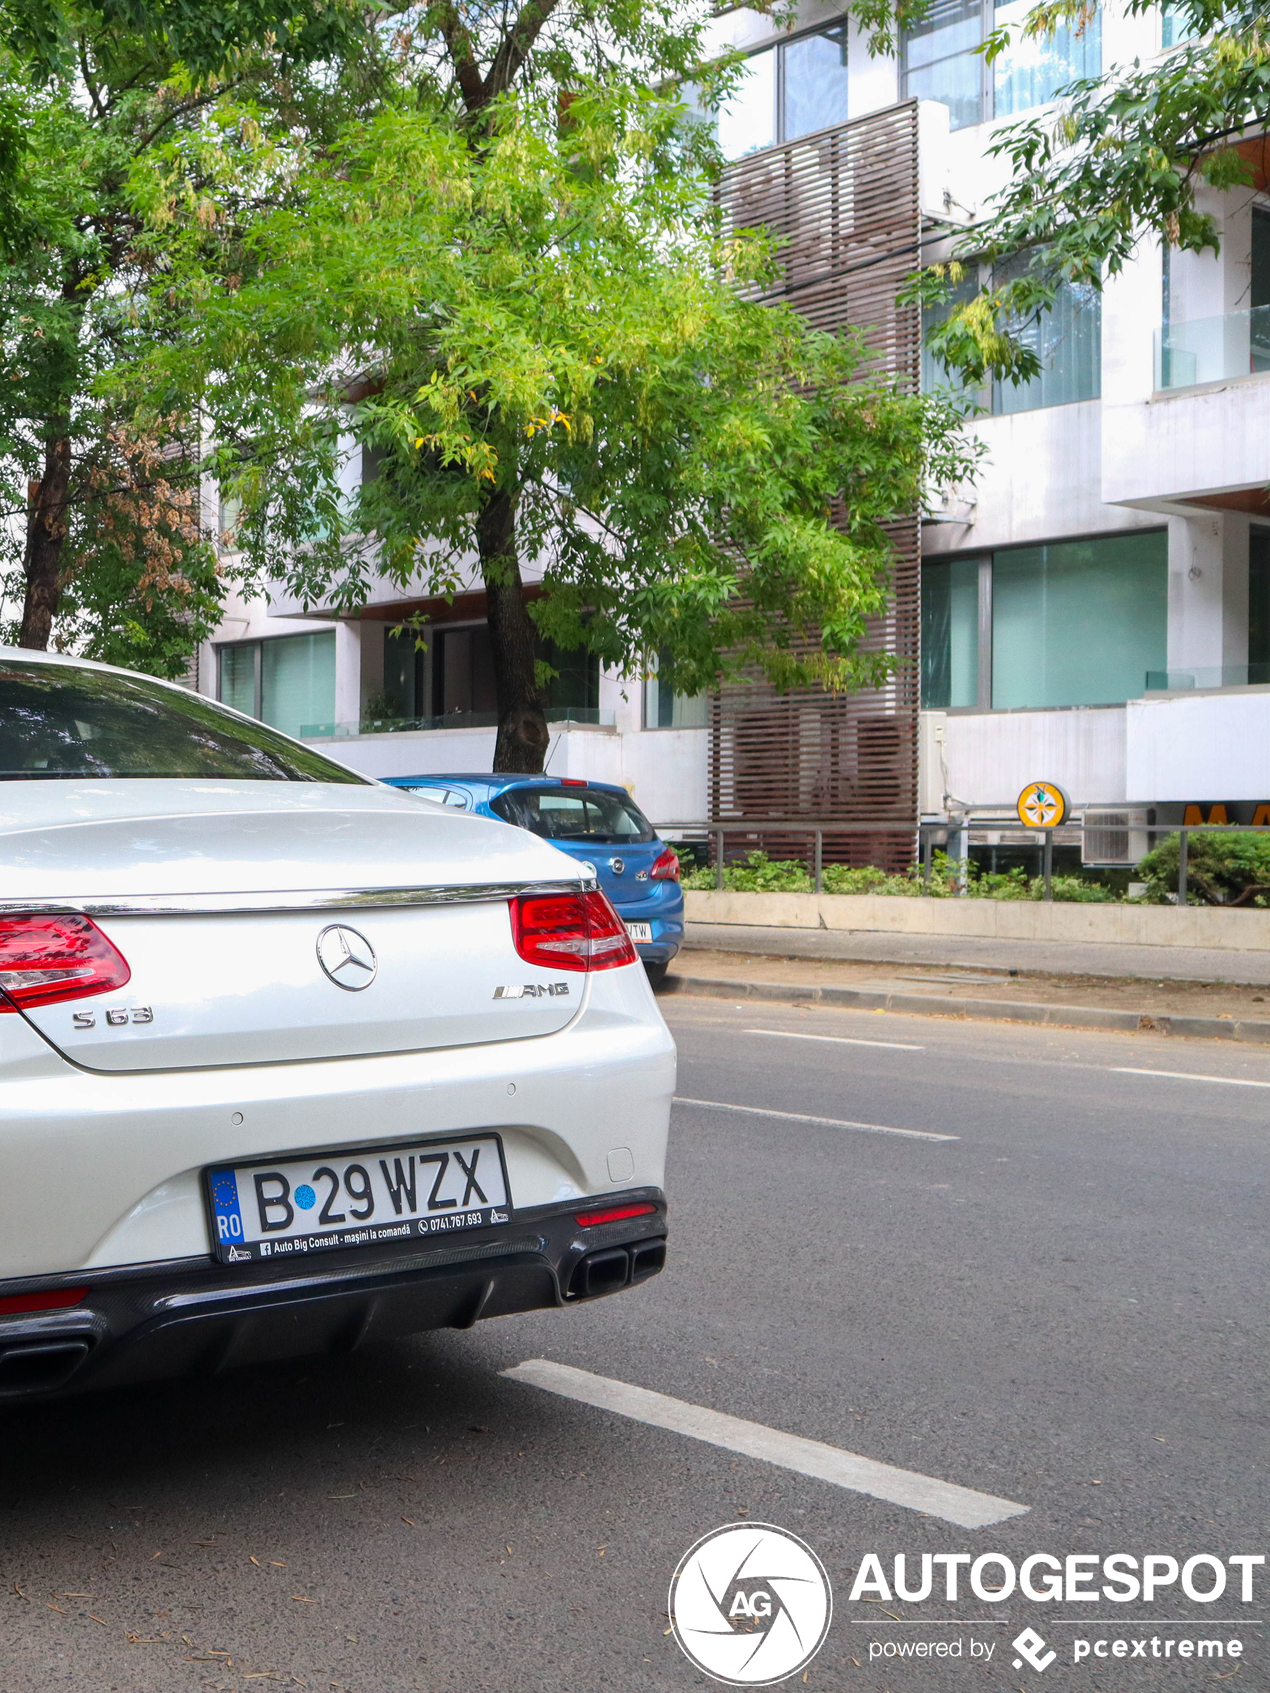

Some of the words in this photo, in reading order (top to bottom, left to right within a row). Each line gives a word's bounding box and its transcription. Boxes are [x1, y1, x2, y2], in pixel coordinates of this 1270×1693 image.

[517, 982, 570, 998] AMG
[72, 1010, 96, 1030] S
[105, 1006, 154, 1027] 63
[253, 1172, 295, 1233] B
[312, 1163, 375, 1226] 29
[378, 1148, 489, 1216] WZX
[216, 1213, 241, 1239] RO
[430, 1212, 482, 1231] 0741.767.693
[274, 1241, 292, 1254] Auto
[293, 1239, 308, 1252] Big
[308, 1234, 339, 1248] Consult
[370, 1229, 378, 1240] la
[378, 1223, 411, 1239] comandă
